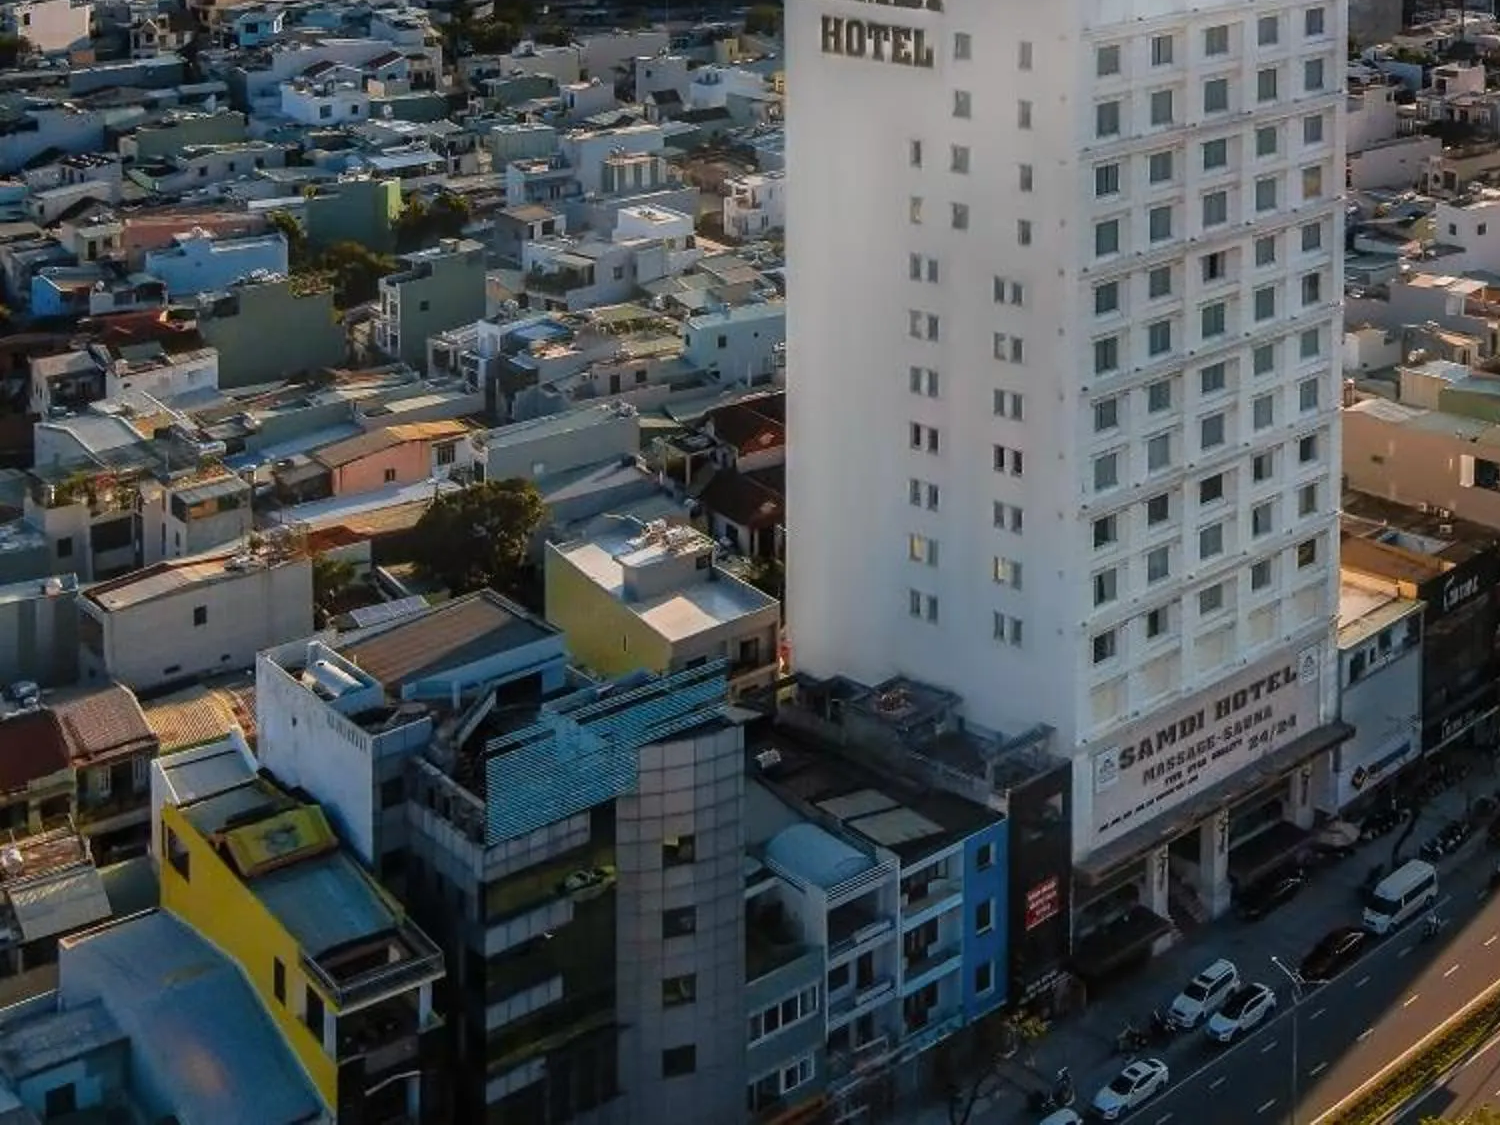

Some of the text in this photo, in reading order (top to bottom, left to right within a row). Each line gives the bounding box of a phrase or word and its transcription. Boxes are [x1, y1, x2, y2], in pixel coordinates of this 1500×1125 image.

[821, 15, 934, 68] HOTEL
[1118, 666, 1297, 770] SAMDI HOTEL
